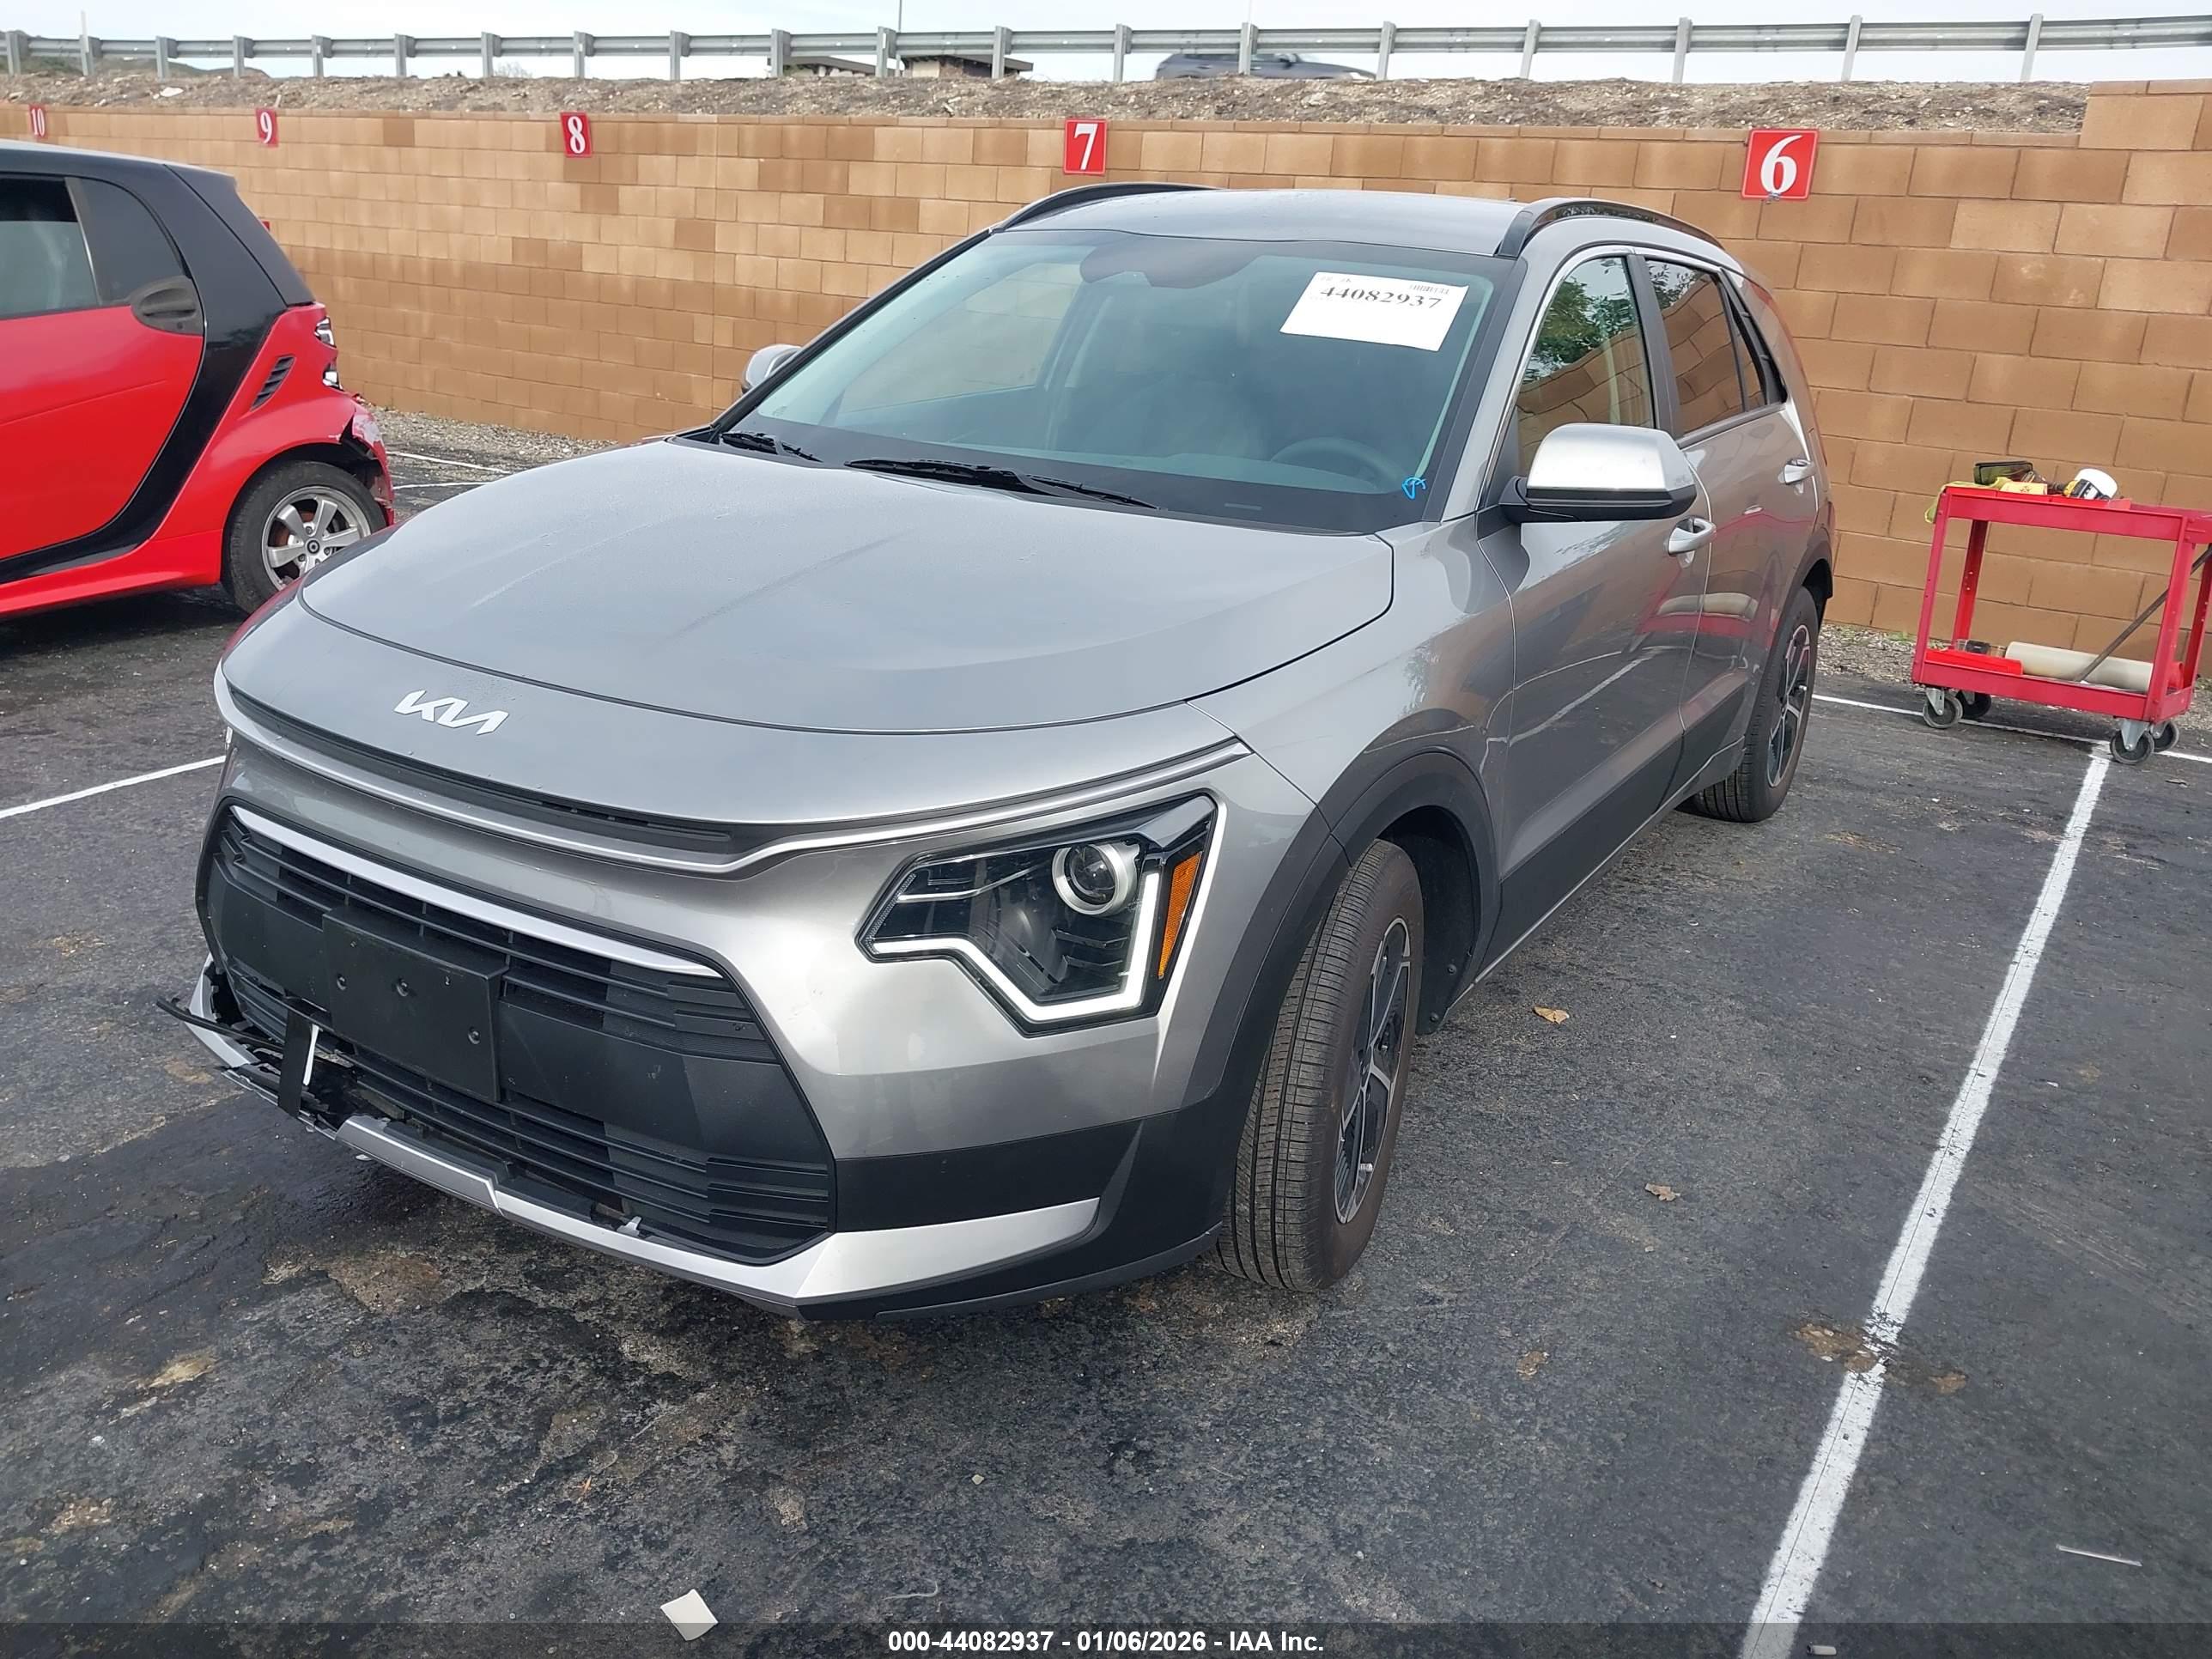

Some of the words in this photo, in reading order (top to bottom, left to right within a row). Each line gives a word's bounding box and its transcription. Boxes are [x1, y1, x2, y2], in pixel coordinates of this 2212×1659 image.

[31, 107, 46, 137] 10
[259, 111, 274, 144] 9
[567, 115, 586, 155] 8
[1073, 123, 1099, 171] 7
[1760, 134, 1803, 196] 6
[1320, 286, 1443, 309] 44082937
[393, 690, 510, 737] KIA
